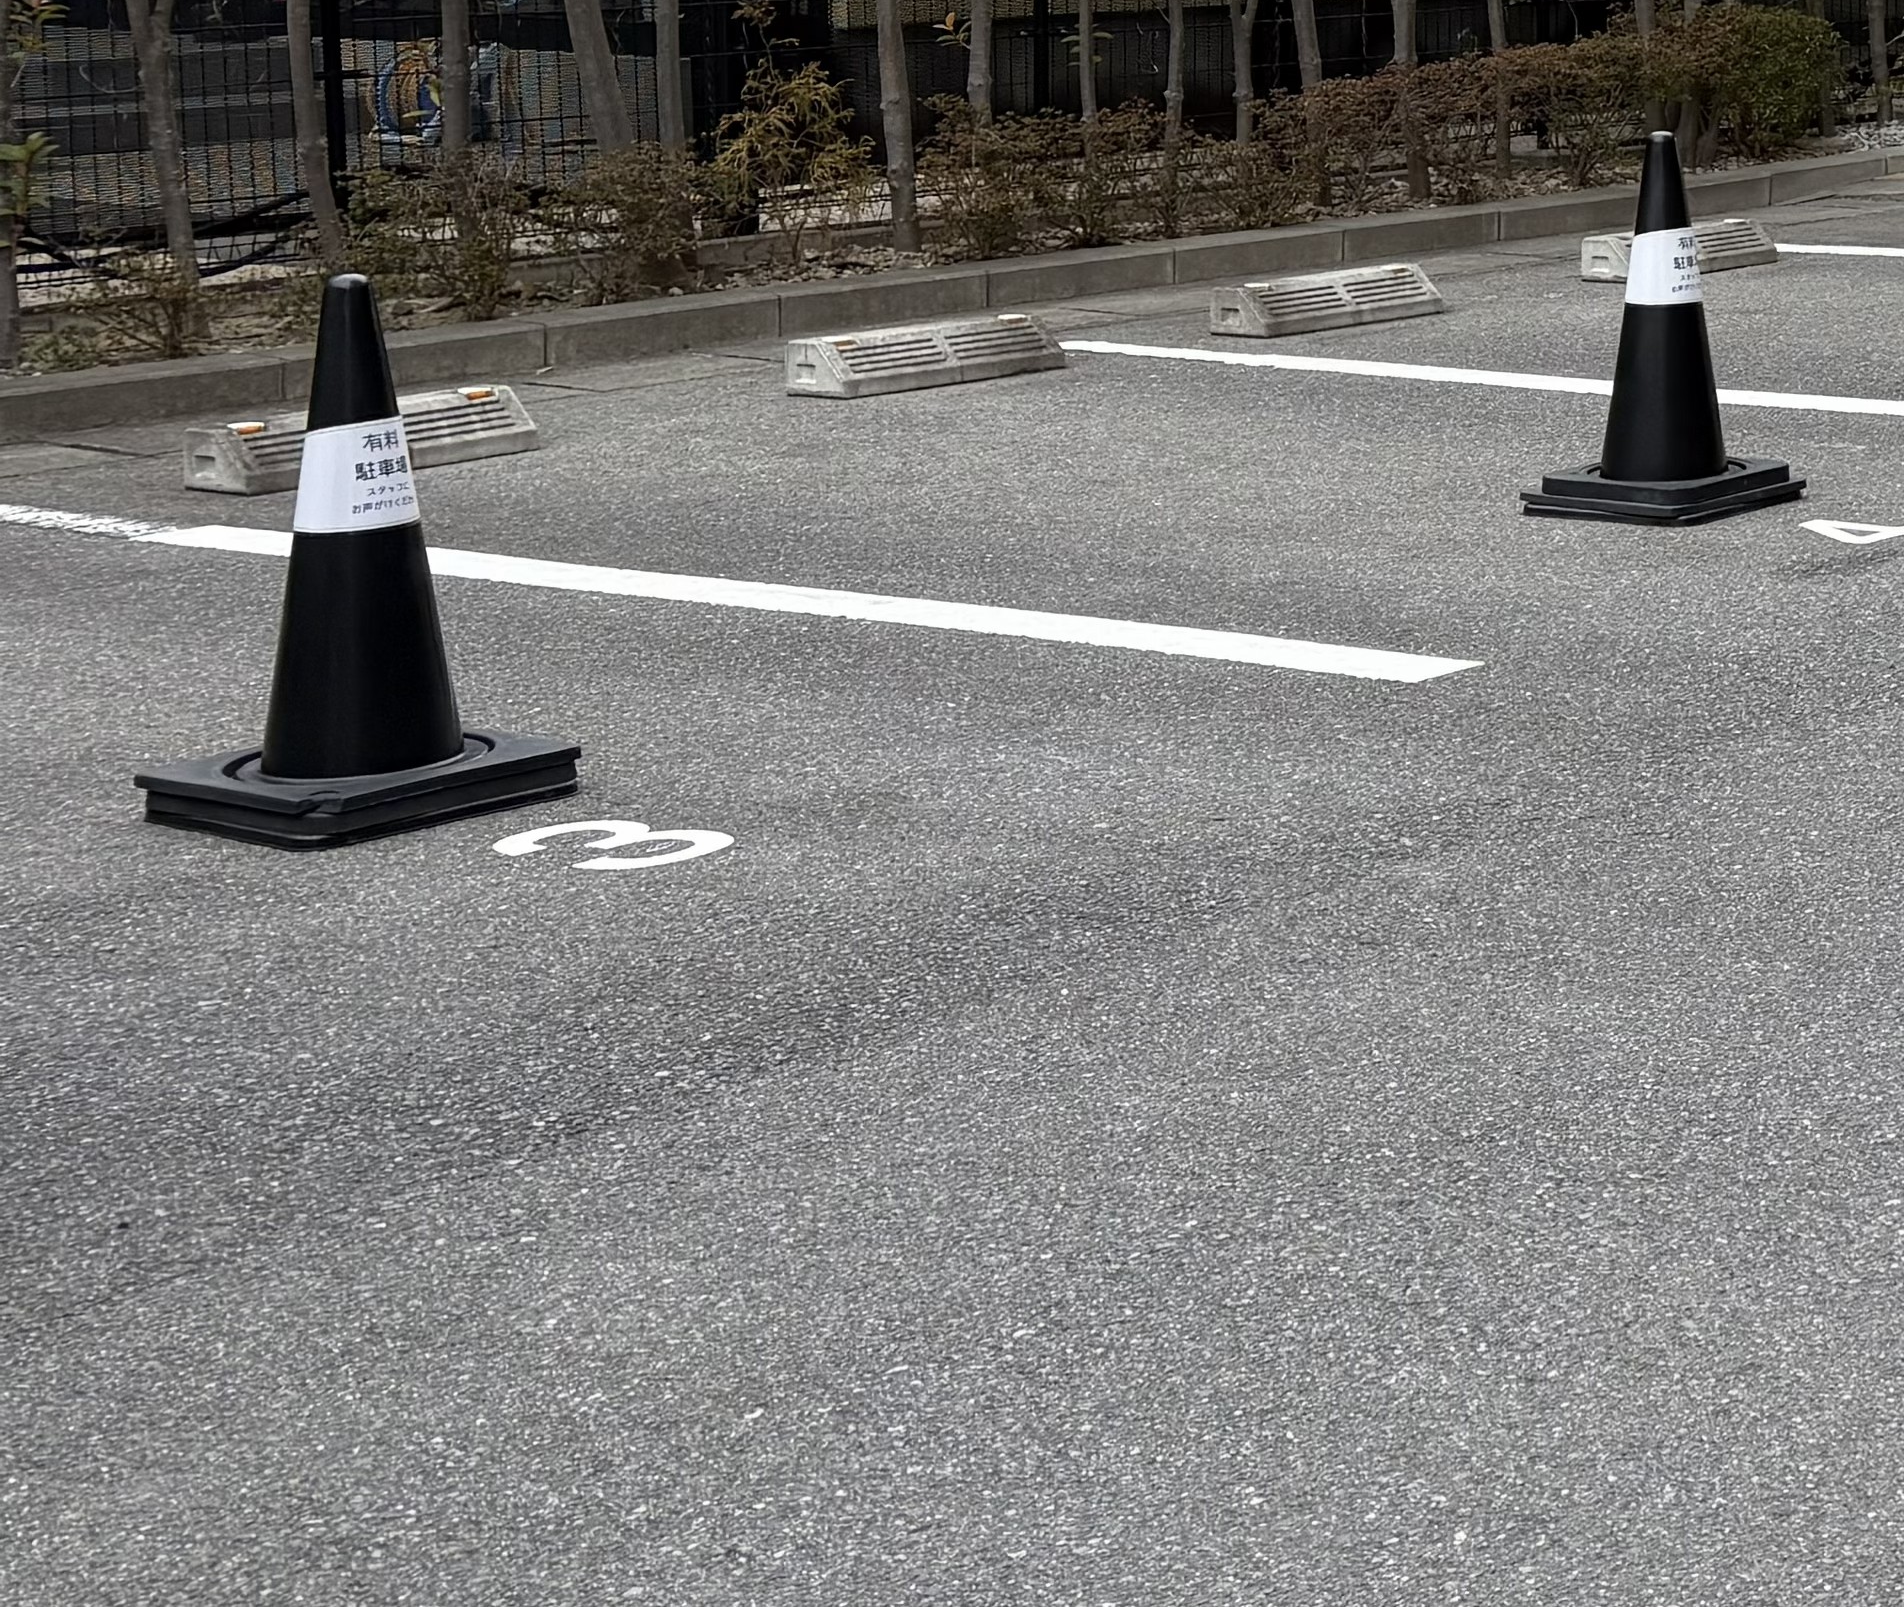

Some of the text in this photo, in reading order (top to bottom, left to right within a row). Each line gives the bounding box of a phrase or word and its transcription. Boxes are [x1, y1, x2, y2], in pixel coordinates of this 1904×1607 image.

[361, 429, 399, 452] 有料
[354, 455, 408, 481] 駐車場
[492, 820, 735, 870] 3
